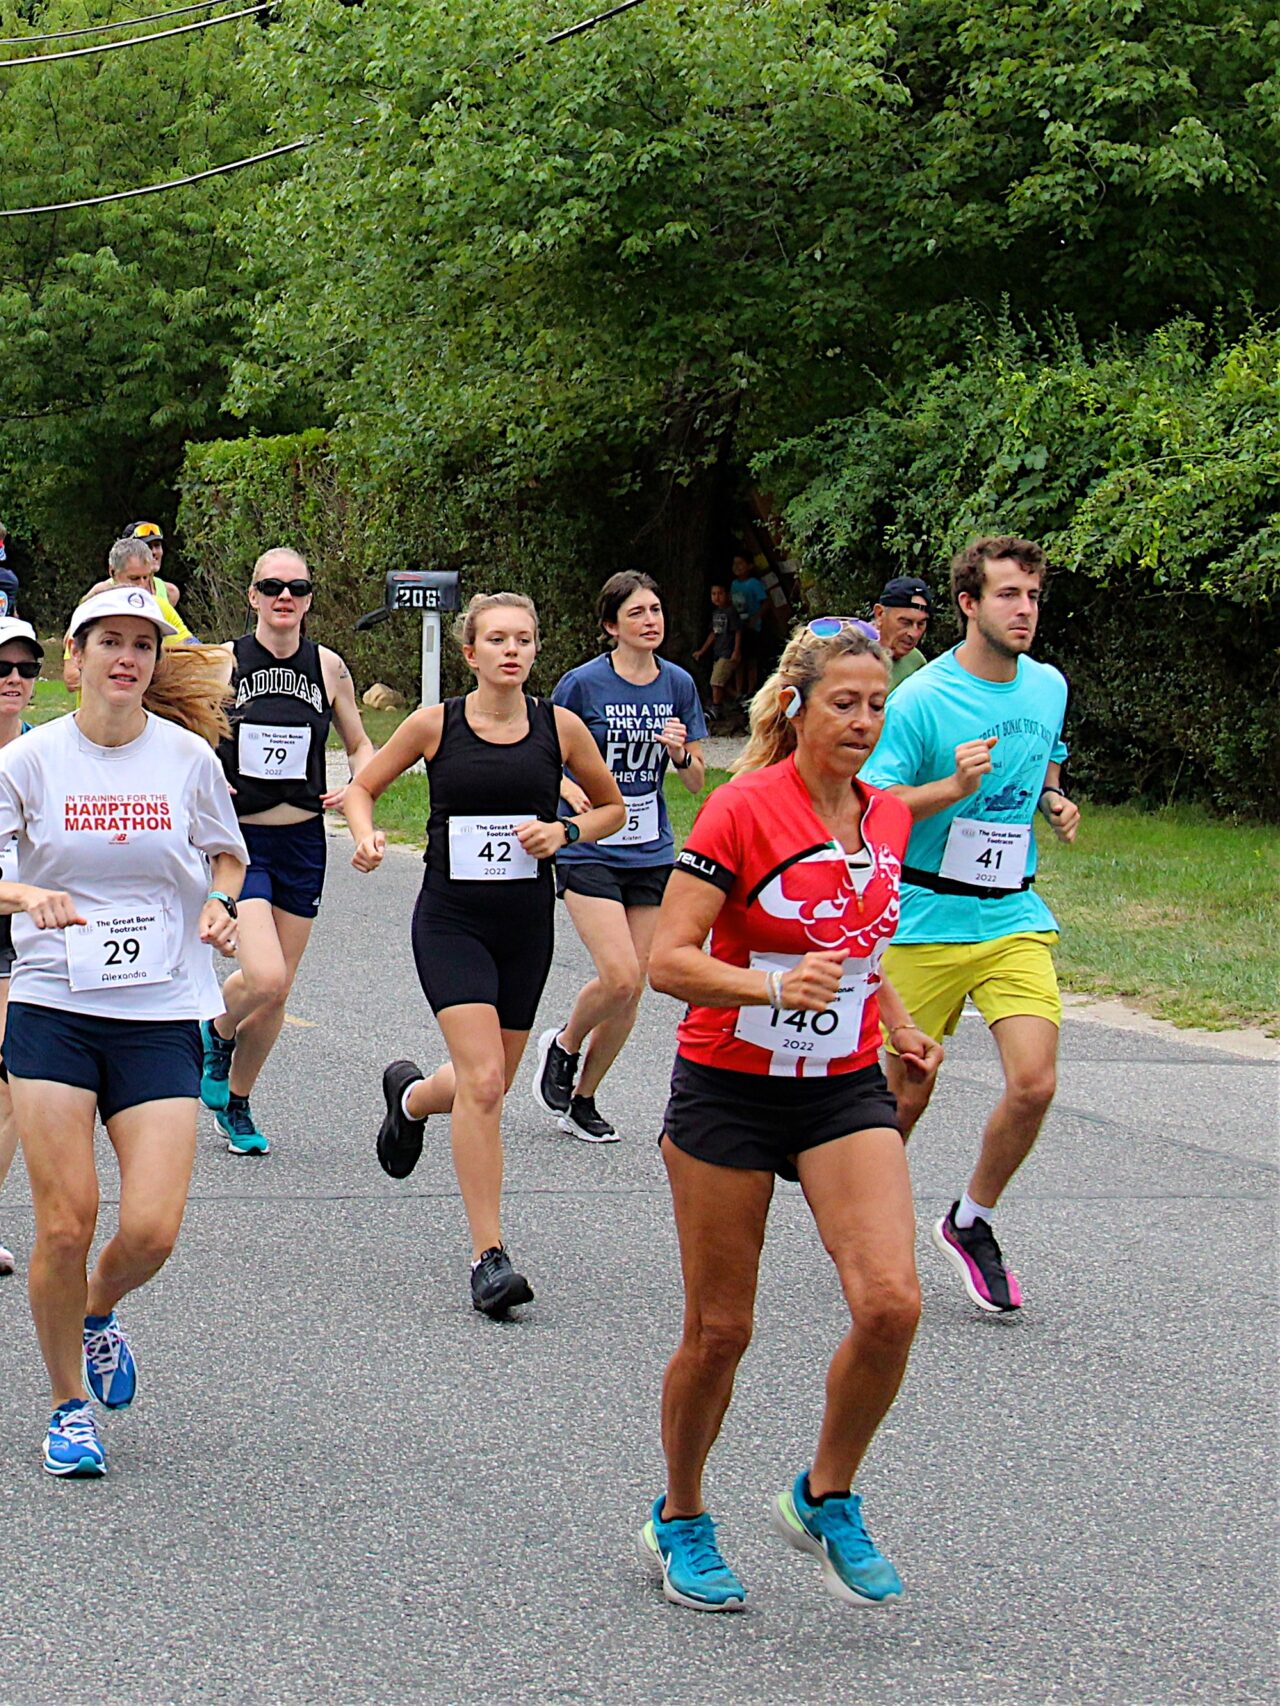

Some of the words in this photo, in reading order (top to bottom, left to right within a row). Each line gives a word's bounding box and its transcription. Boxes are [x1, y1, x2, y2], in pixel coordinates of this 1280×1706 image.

[399, 589, 437, 607] 206
[235, 667, 323, 713] ADIDAS
[605, 704, 637, 717] RUN
[641, 704, 650, 716] A
[653, 704, 674, 716] 10K
[606, 717, 643, 729] THEY
[1002, 718, 1022, 736] BONAC
[607, 729, 622, 741] IT
[262, 747, 287, 765] 79
[127, 794, 147, 802] FOR
[65, 802, 170, 815] HAMPTONS
[65, 817, 172, 831] MARATHON
[628, 815, 639, 831] 5
[477, 841, 512, 862] 42
[976, 847, 1003, 870] 41
[484, 867, 506, 876] 2022
[976, 873, 997, 883] 2022
[96, 919, 111, 928] The
[112, 916, 135, 926] Great
[136, 915, 156, 924] Bonac
[110, 924, 147, 935] Footraces
[103, 937, 140, 966] 29
[101, 970, 147, 982] Alexandra
[770, 1005, 839, 1036] 140
[782, 1038, 815, 1051] 2022
